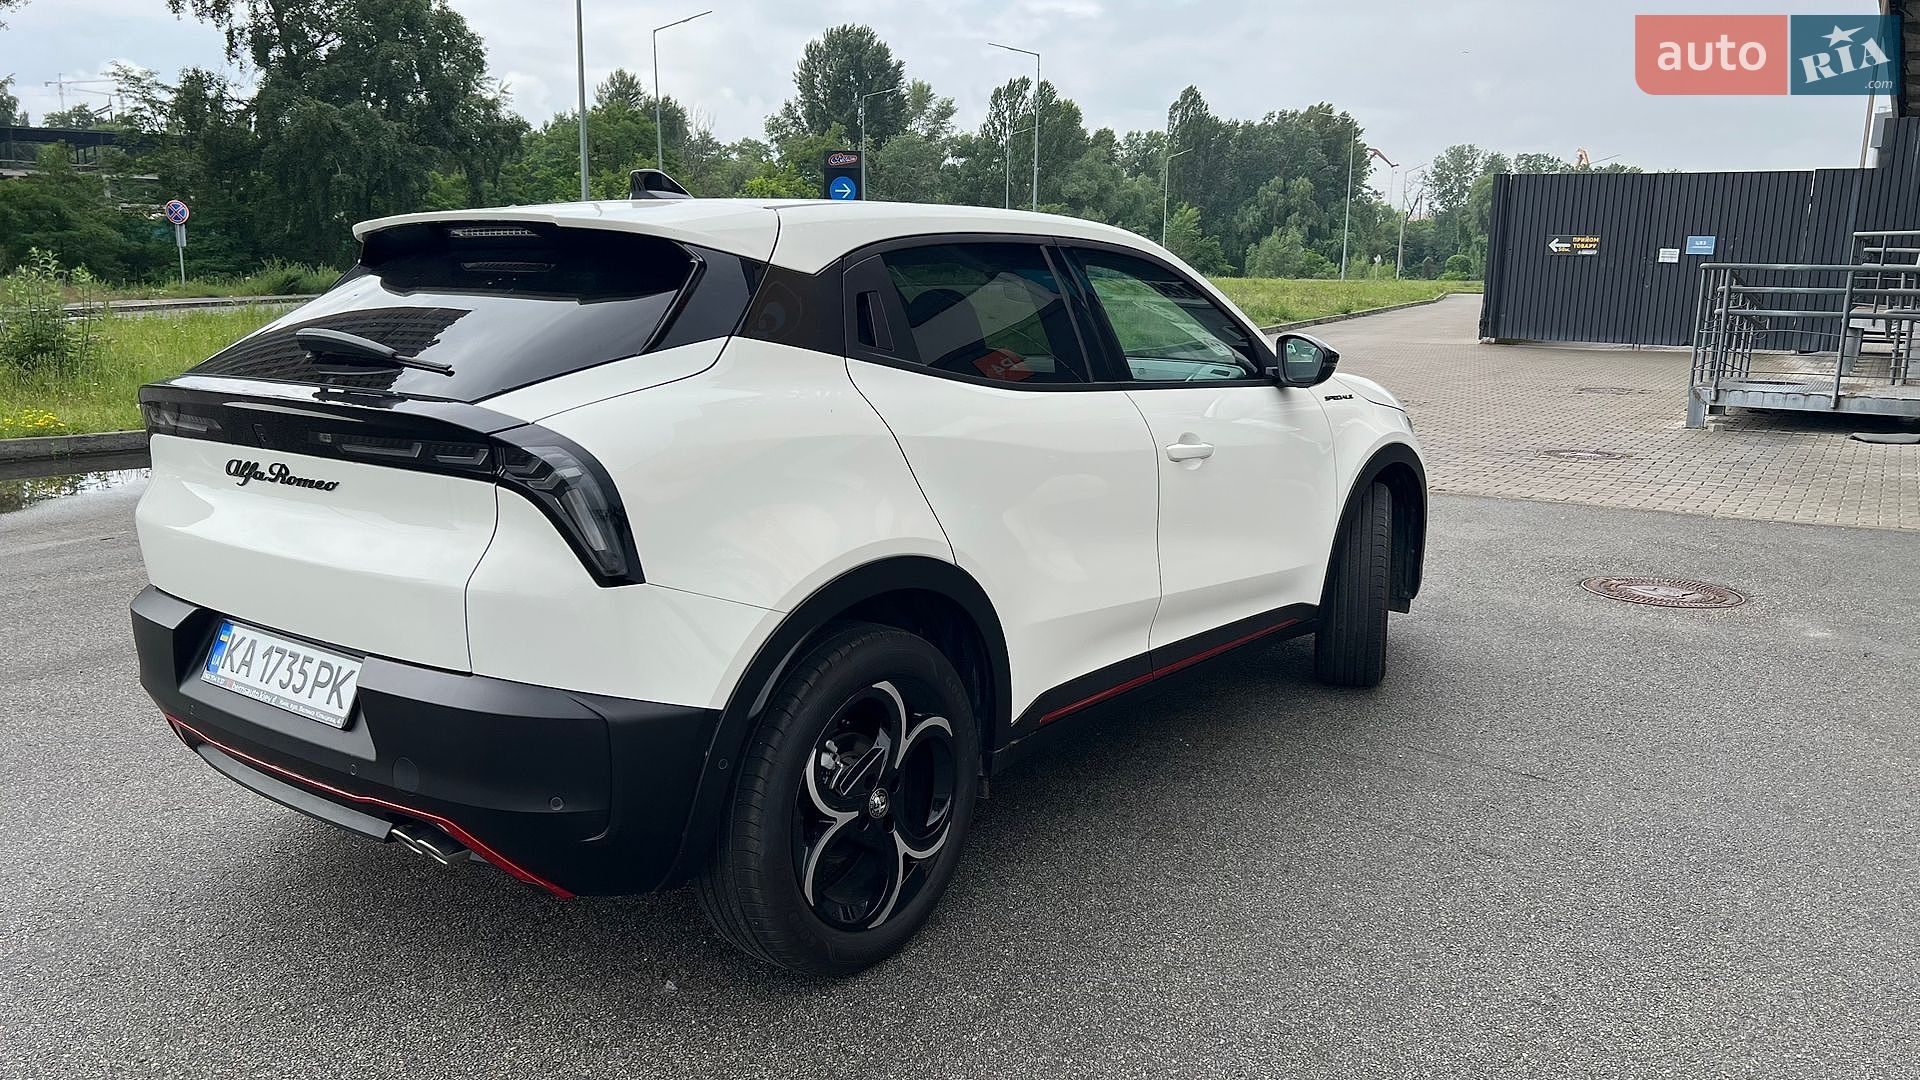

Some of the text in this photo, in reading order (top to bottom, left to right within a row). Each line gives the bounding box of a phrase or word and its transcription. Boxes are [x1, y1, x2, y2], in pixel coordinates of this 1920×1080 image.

[225, 459, 340, 491] Alfa Romeo
[221, 633, 356, 710] KA 1735 PK
